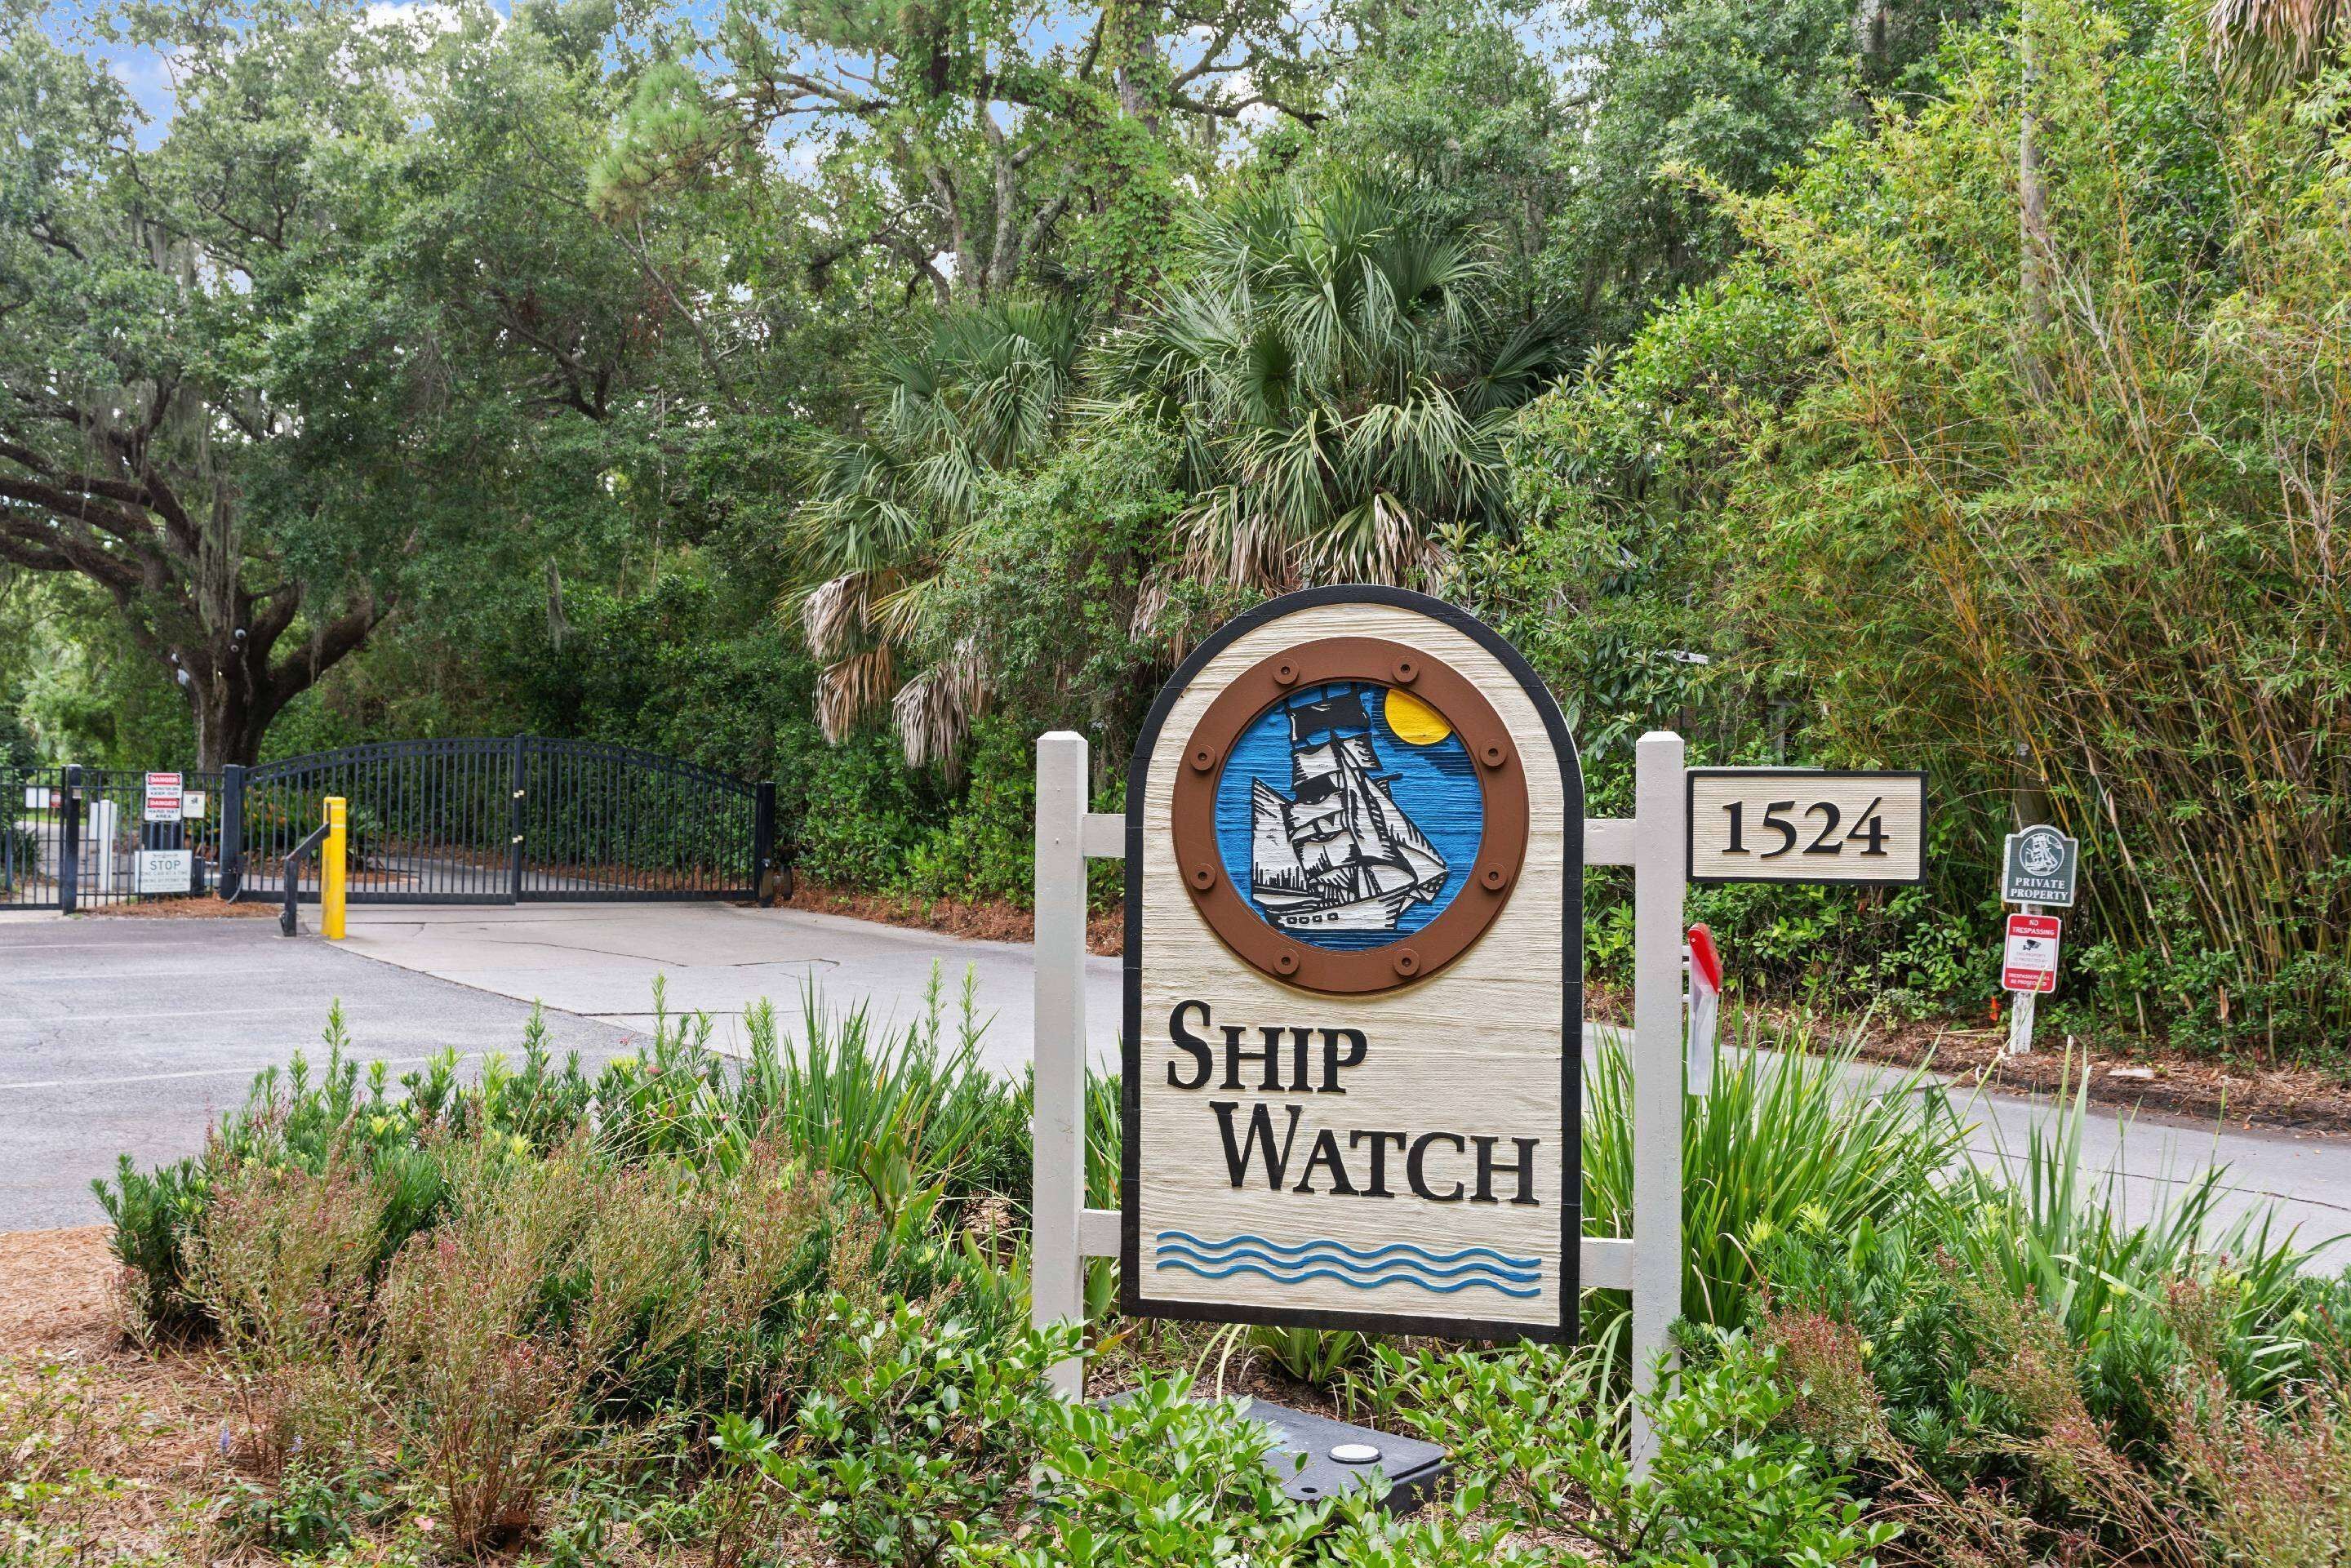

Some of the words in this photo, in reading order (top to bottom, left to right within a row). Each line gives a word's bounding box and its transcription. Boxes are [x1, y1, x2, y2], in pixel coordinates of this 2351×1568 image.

[1722, 797, 1890, 858] 1524
[150, 860, 181, 871] STOP
[2015, 877, 2065, 890] PRIVATE
[2011, 888, 2069, 901] PROPERTY
[2012, 926, 2055, 936] TRESPASSING
[1167, 999, 1368, 1094] SHIP
[1209, 1100, 1540, 1206] WATCH
